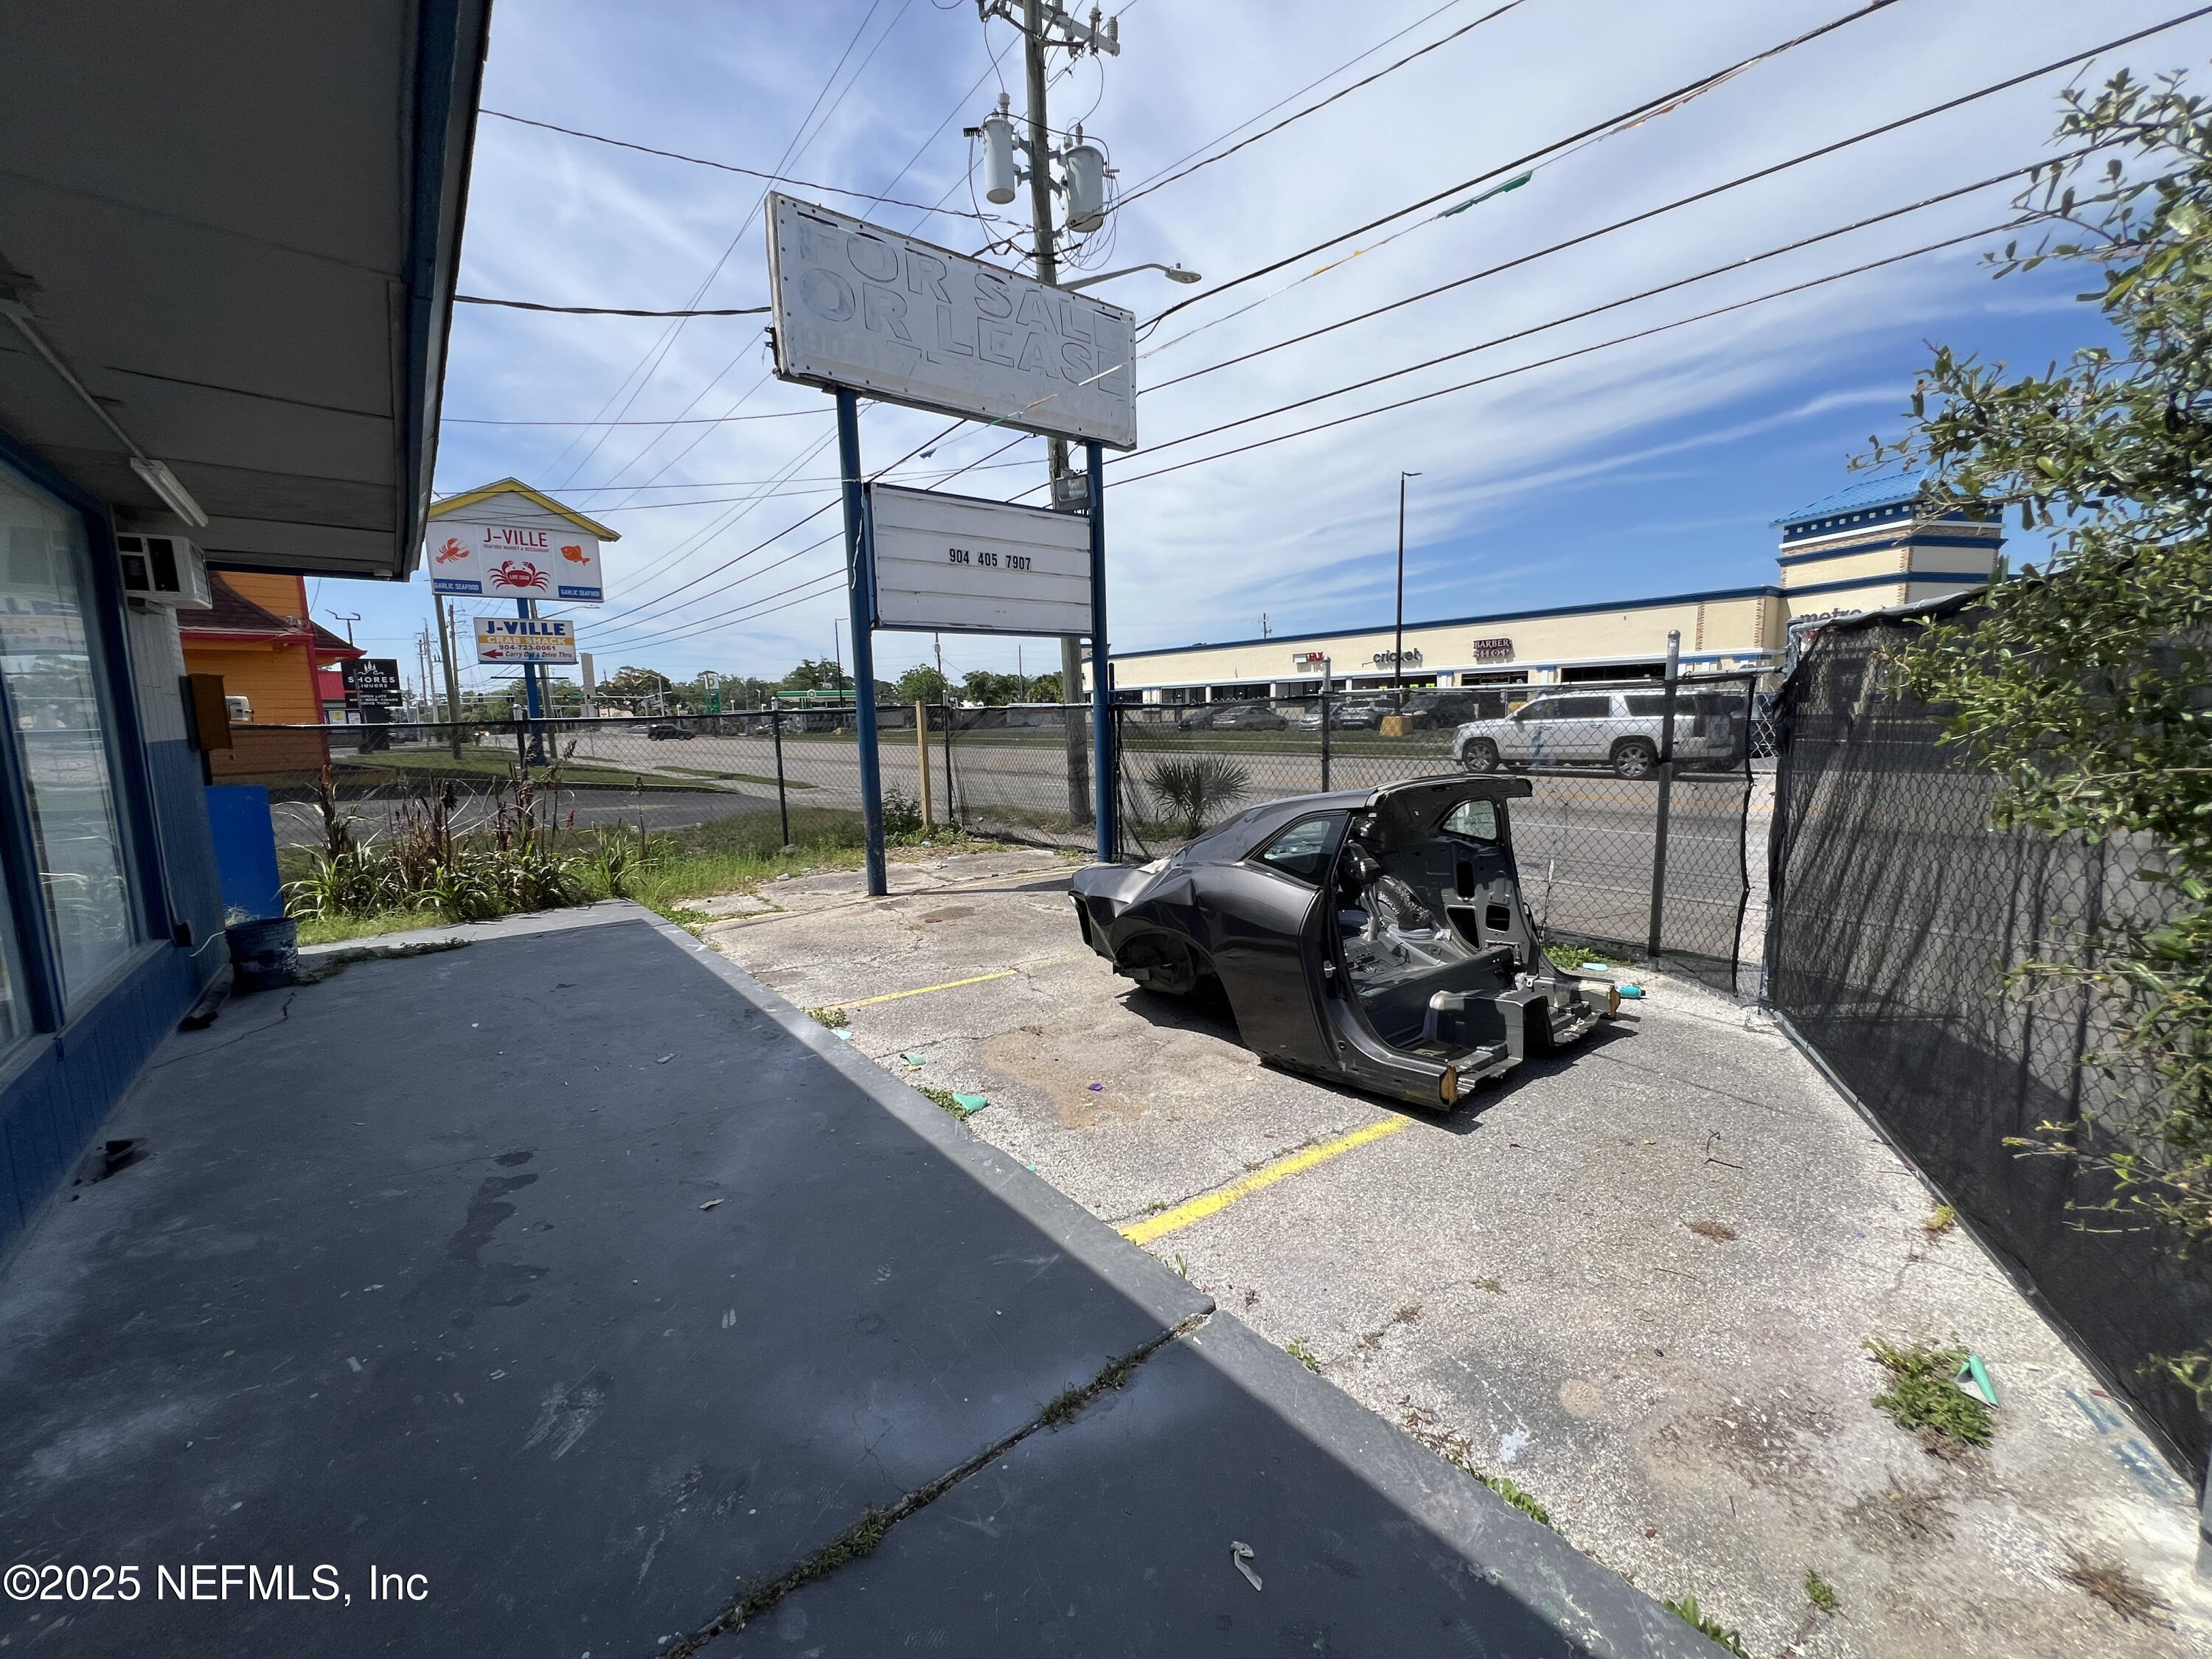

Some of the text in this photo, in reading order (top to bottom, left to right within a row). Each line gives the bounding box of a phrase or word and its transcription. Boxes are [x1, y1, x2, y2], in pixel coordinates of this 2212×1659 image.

[484, 527, 548, 547] J-VILLE
[950, 549, 1031, 571] 904 405 7907
[434, 582, 454, 590] GARLIC
[486, 620, 566, 636] J-VILLE
[487, 636, 521, 644] CRAB
[1475, 639, 1510, 649] BARBER
[1474, 649, 1509, 658] SHOP
